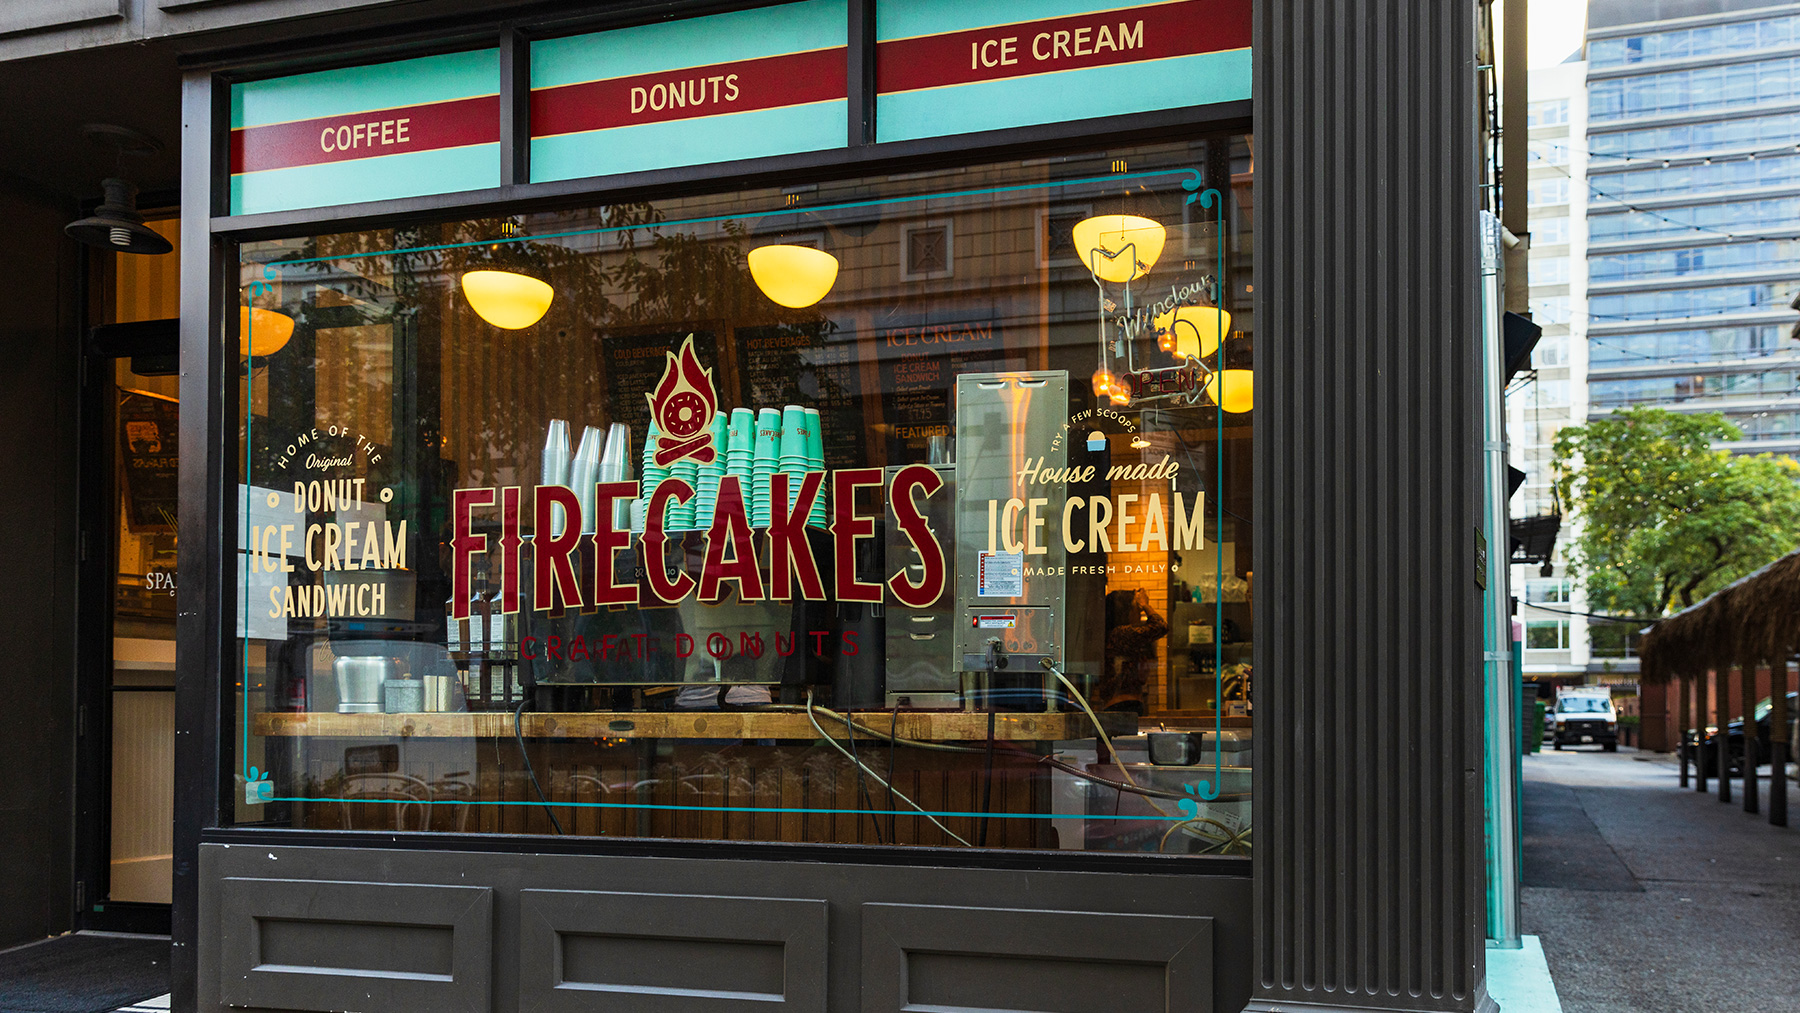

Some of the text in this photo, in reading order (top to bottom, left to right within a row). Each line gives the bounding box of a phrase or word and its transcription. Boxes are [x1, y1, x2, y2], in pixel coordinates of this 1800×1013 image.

[971, 20, 1144, 70] ICE CREAM
[630, 73, 740, 114] DONUTS
[320, 118, 411, 153] COFFEE
[746, 335, 811, 350] HOT BEVERAGES
[885, 321, 993, 348] ICE CREAM
[895, 371, 941, 384] SANDWICH
[909, 360, 941, 373] CREAM
[1121, 367, 1196, 398] OPEN
[894, 424, 951, 439] FEATURED
[1051, 407, 1137, 453] TRY A FEW SCOOPS
[277, 425, 382, 470] HOME OF THE
[305, 453, 353, 472] Original
[1016, 454, 1180, 487] House made
[294, 478, 366, 514] DONUT
[988, 490, 1206, 556] ICE CREAM
[252, 519, 407, 573] ICE CREAM
[450, 464, 947, 621] FIRECAKES
[146, 571, 178, 590] SPA
[1023, 564, 1166, 576] MADE FRESH DAILY
[268, 582, 386, 619] SANDWICH
[521, 632, 648, 661] CRAFT
[676, 630, 860, 659] DONUTS
